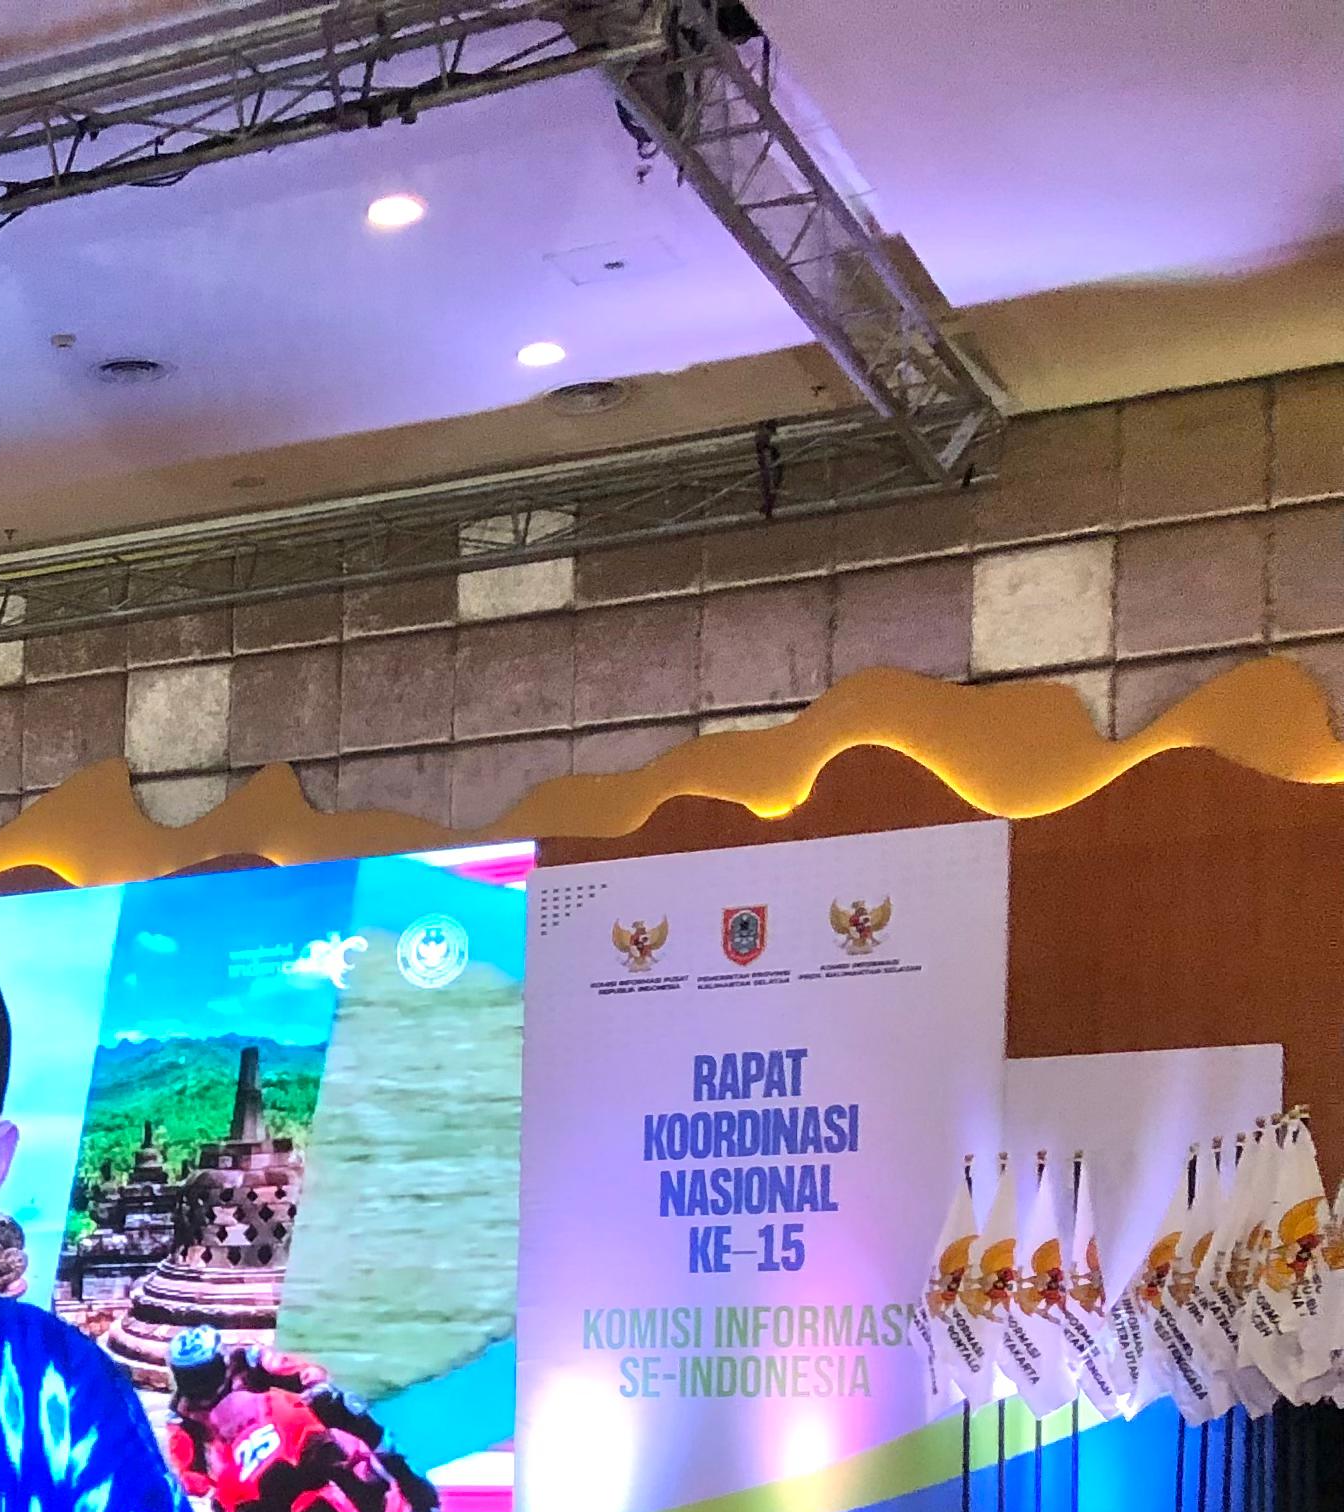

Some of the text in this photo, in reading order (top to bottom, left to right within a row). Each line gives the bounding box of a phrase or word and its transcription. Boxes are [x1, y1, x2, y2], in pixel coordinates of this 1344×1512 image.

[693, 1048, 808, 1102] RAPAT
[643, 1104, 859, 1162] KOORDINASI
[659, 1164, 839, 1218] NASIONAL
[583, 1306, 703, 1350] KOMISI
[619, 1355, 872, 1398] SE-INDONESIA
[1003, 1332, 1041, 1385] YAKARTA
[233, 1423, 281, 1482] 25
